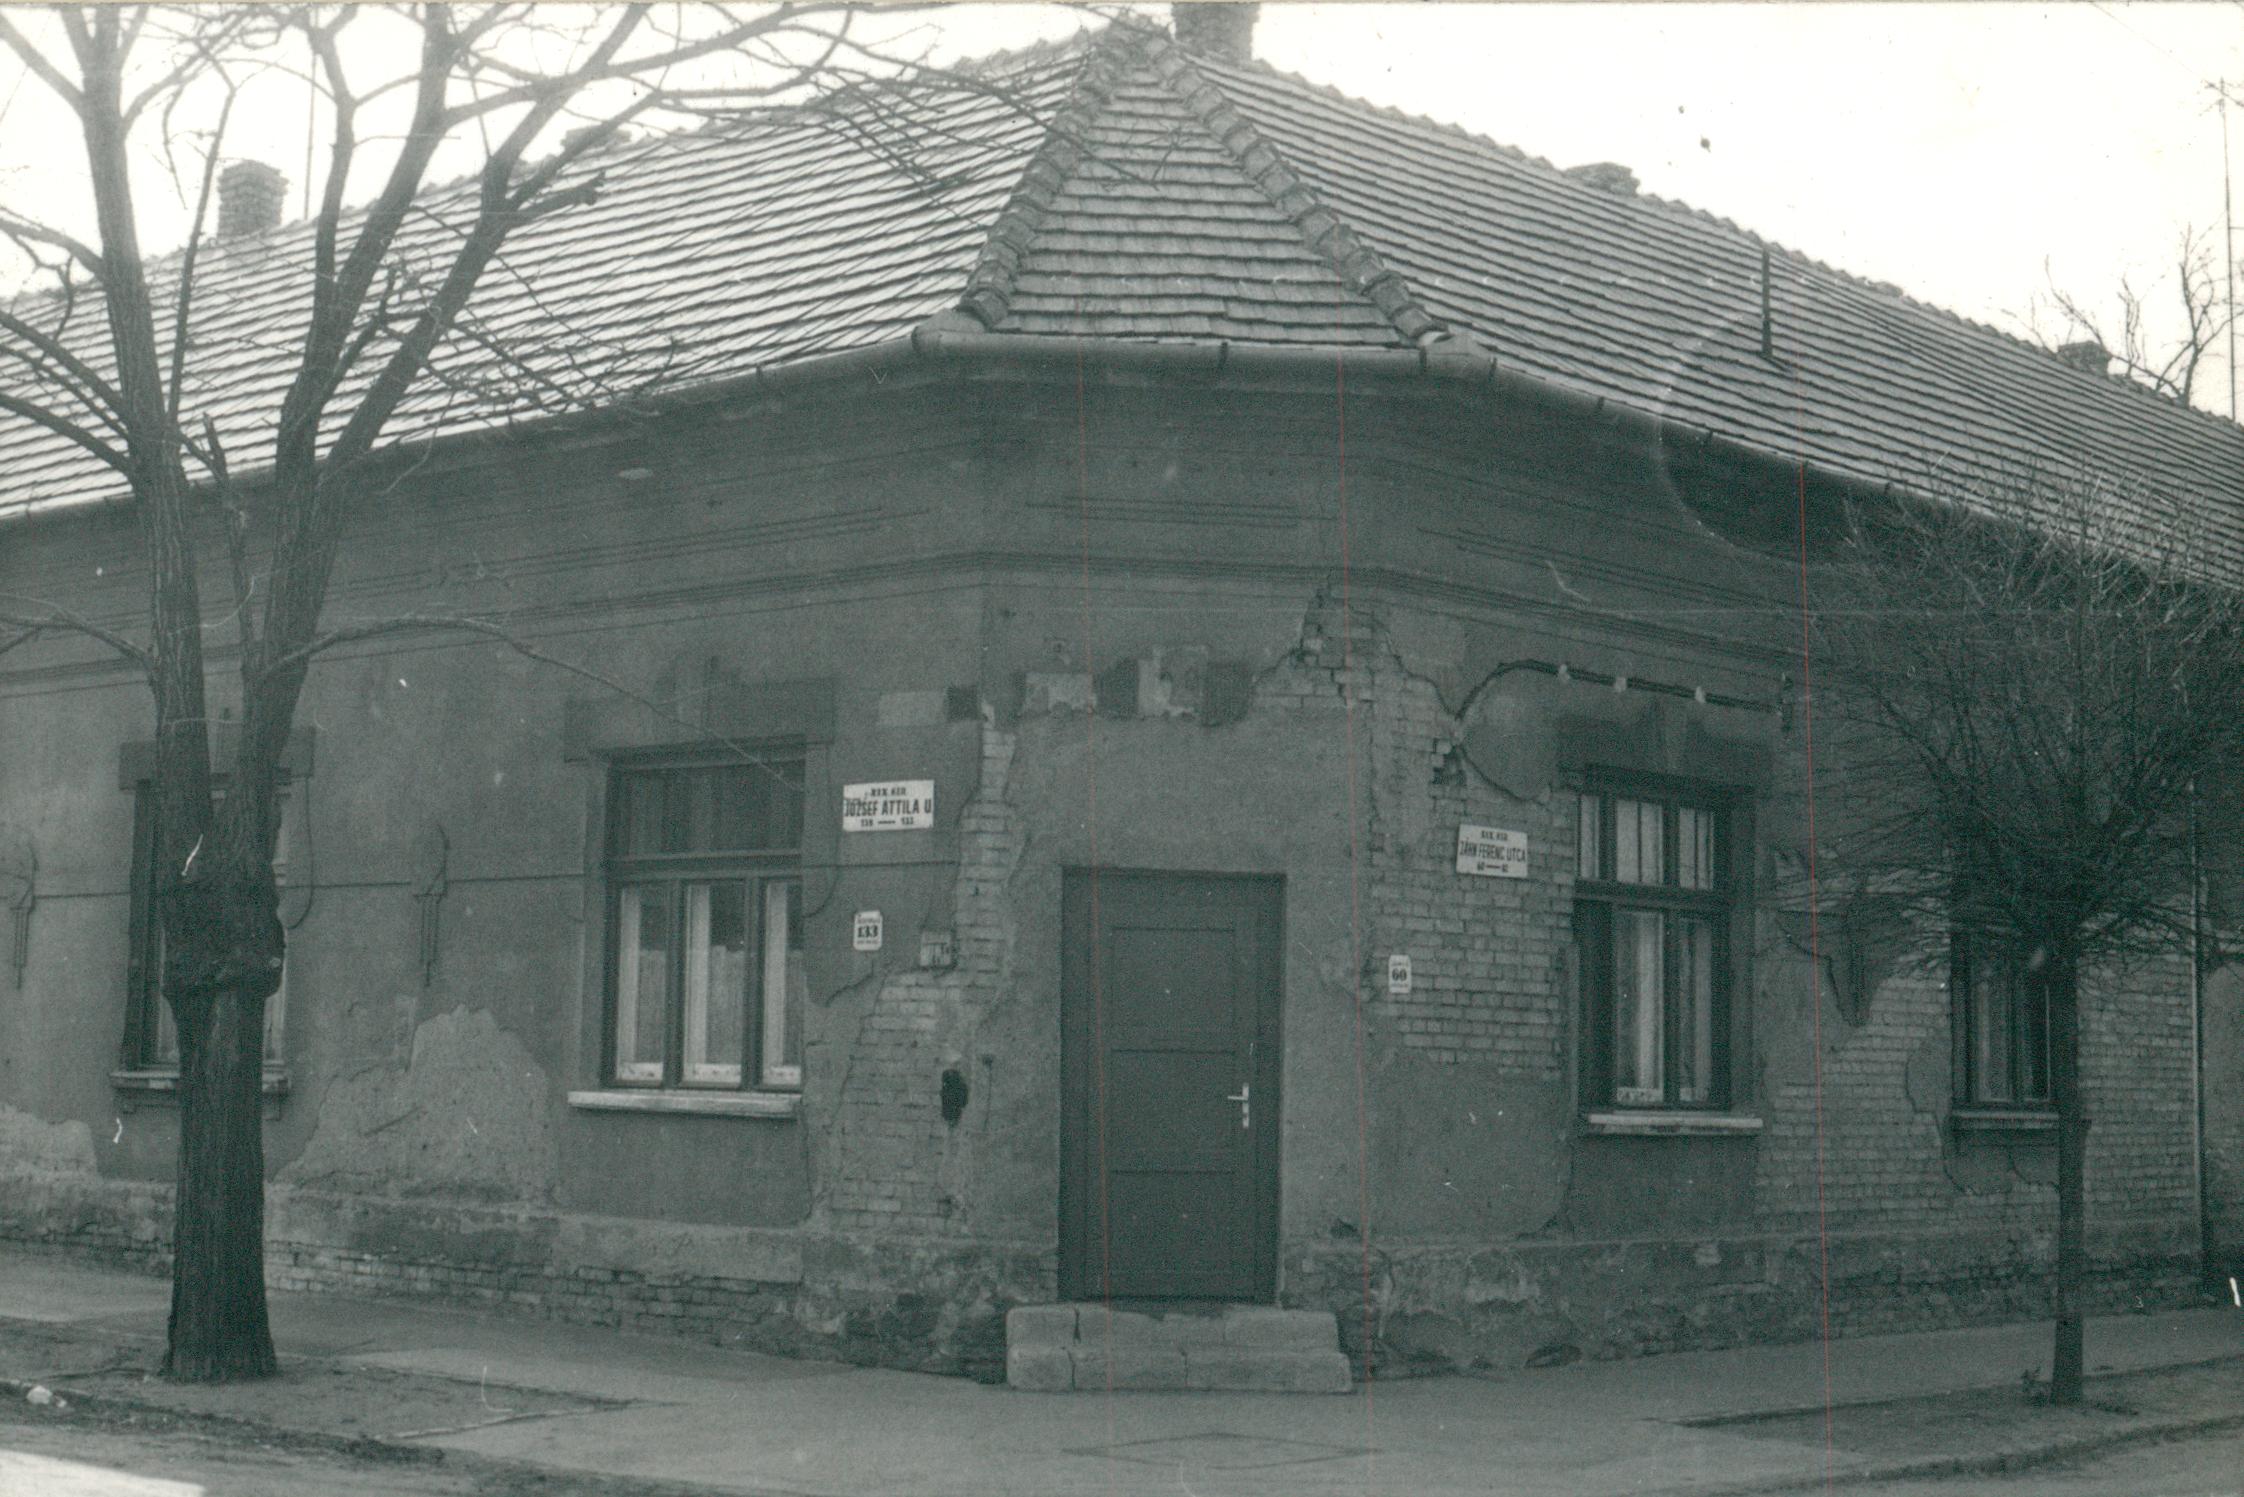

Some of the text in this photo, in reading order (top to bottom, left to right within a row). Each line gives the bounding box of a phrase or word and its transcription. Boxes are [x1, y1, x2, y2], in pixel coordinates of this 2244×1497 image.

[881, 799, 919, 816] ATTILA
[1478, 843, 1505, 860] FERENC
[1506, 847, 1526, 862] UTCA
[857, 925, 879, 938] 133
[1392, 967, 1407, 982] 60
